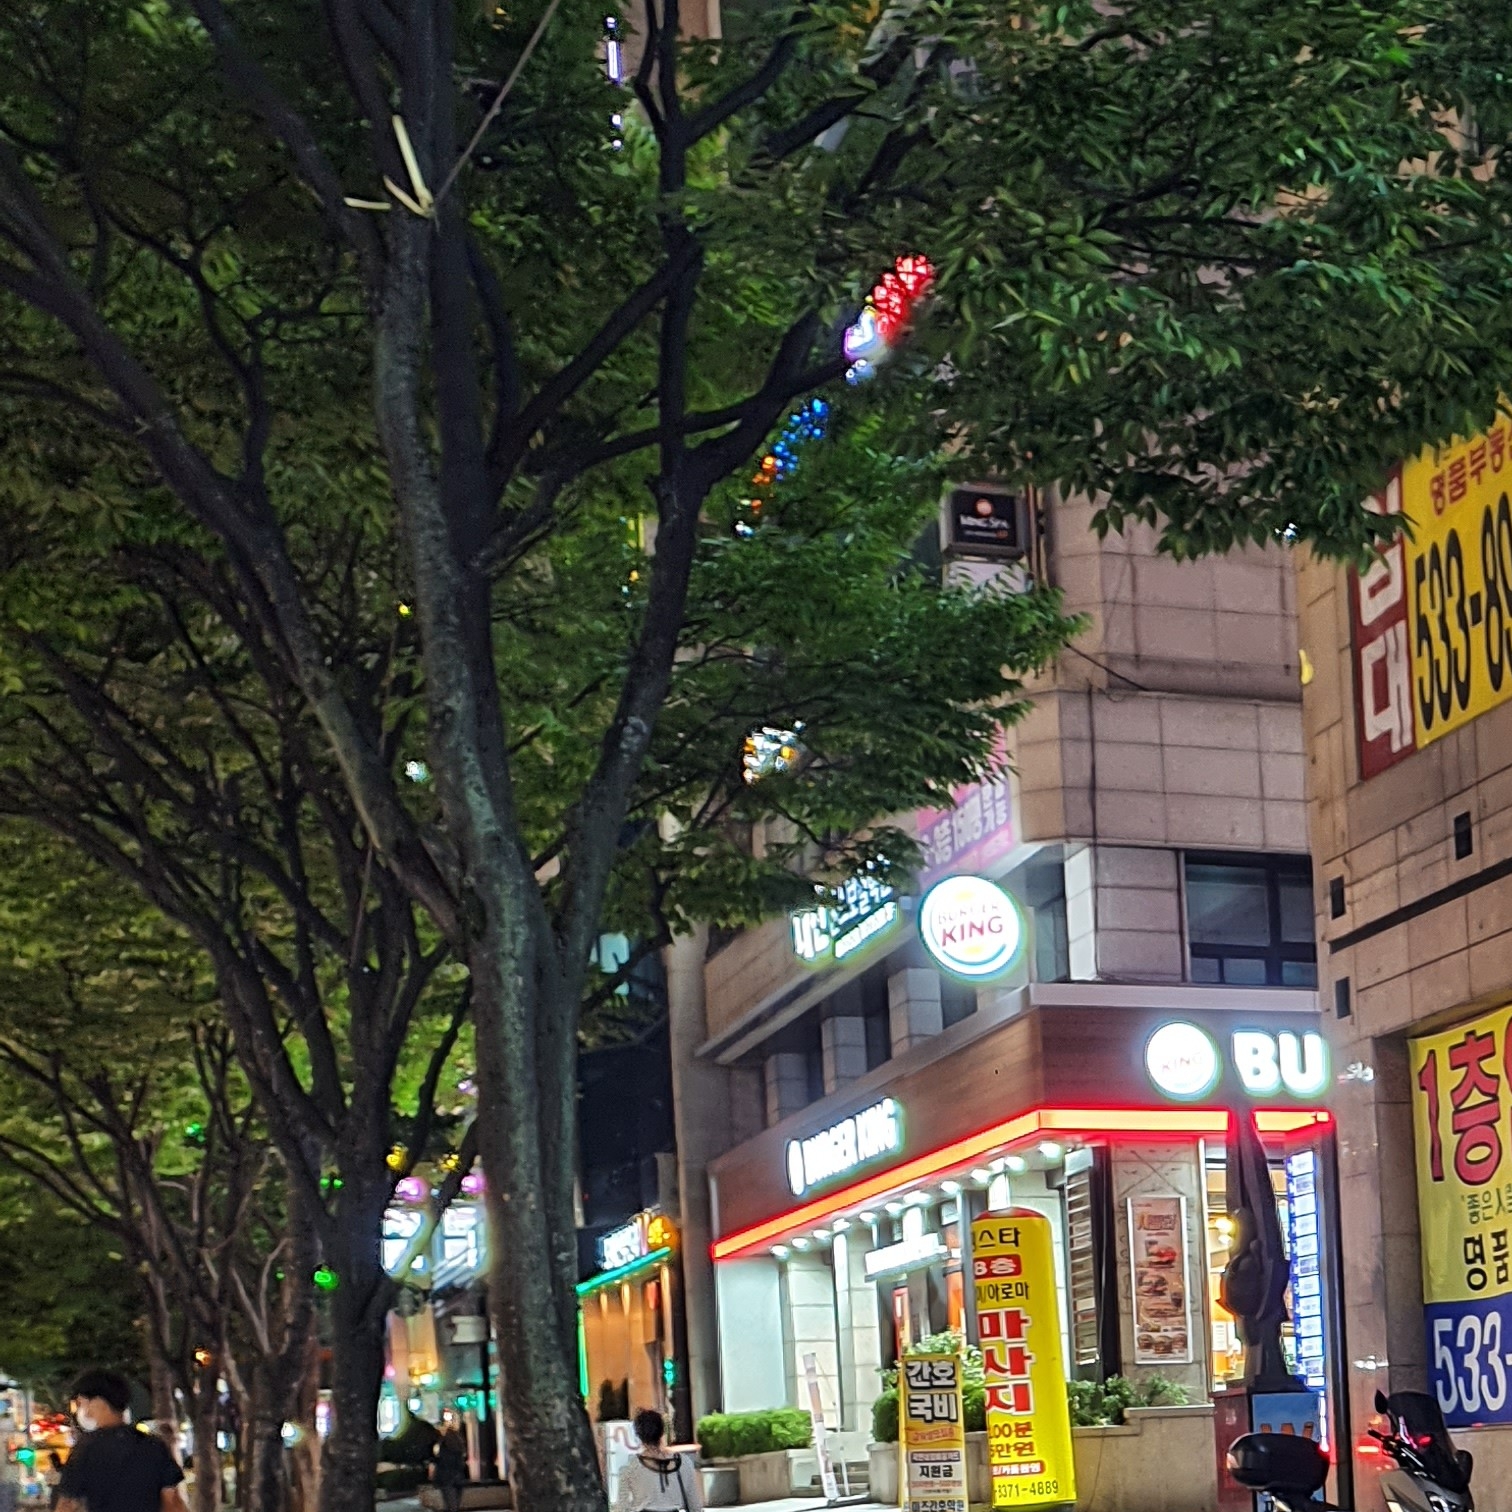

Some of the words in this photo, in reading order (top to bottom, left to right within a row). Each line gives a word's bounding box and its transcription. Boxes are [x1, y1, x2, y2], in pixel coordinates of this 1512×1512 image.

[941, 915, 1004, 948] KING
[906, 1360, 957, 1389] 간호
[908, 1393, 958, 1423] 국비
[919, 1464, 954, 1478] 지원금
